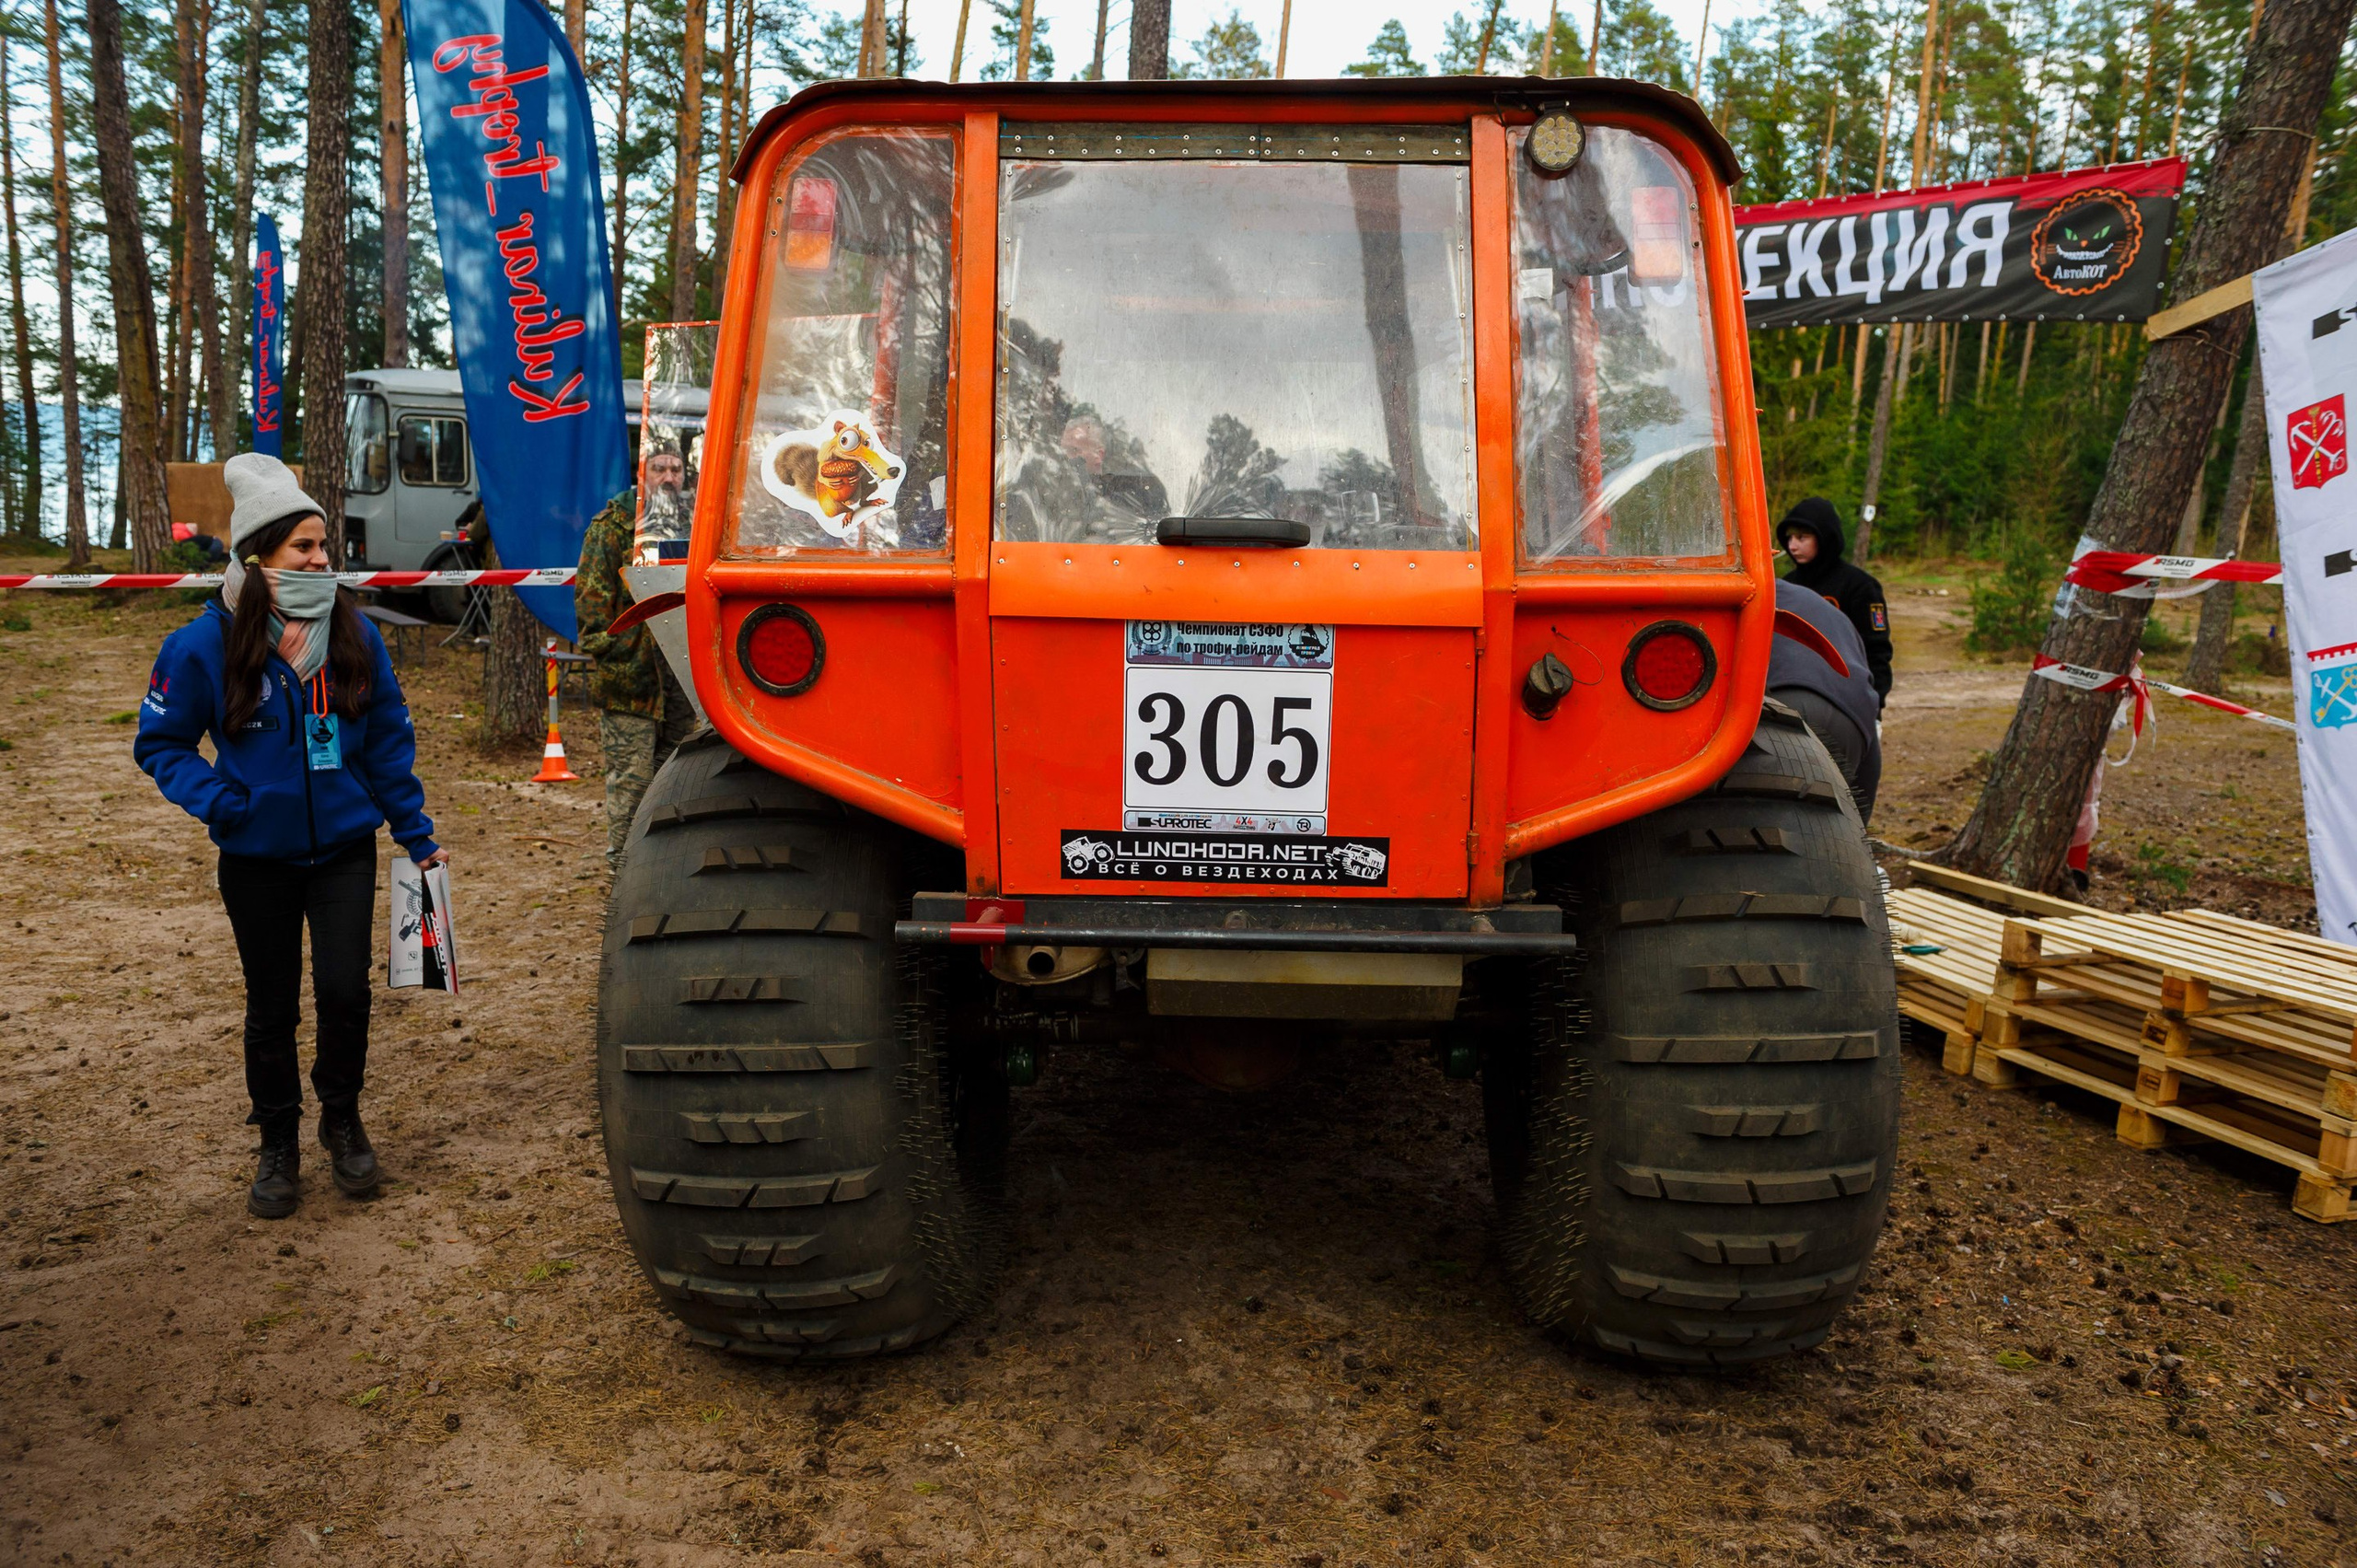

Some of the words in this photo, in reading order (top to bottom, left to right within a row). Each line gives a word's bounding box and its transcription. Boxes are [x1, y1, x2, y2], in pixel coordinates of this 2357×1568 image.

[1177, 621, 1247, 636] Чемпионат
[1248, 624, 1283, 637] СЗФО
[1177, 642, 1190, 653] по
[1195, 642, 1283, 656] трофи-рейдам
[1134, 692, 1318, 789] 305
[1150, 817, 1212, 829] SUPROTEC
[1116, 840, 1328, 862] LUNOHODA.NET
[1098, 862, 1141, 875] ВСЁ
[1155, 865, 1167, 876] О
[1183, 865, 1338, 881] ВЕЗДЕХОДАХ
